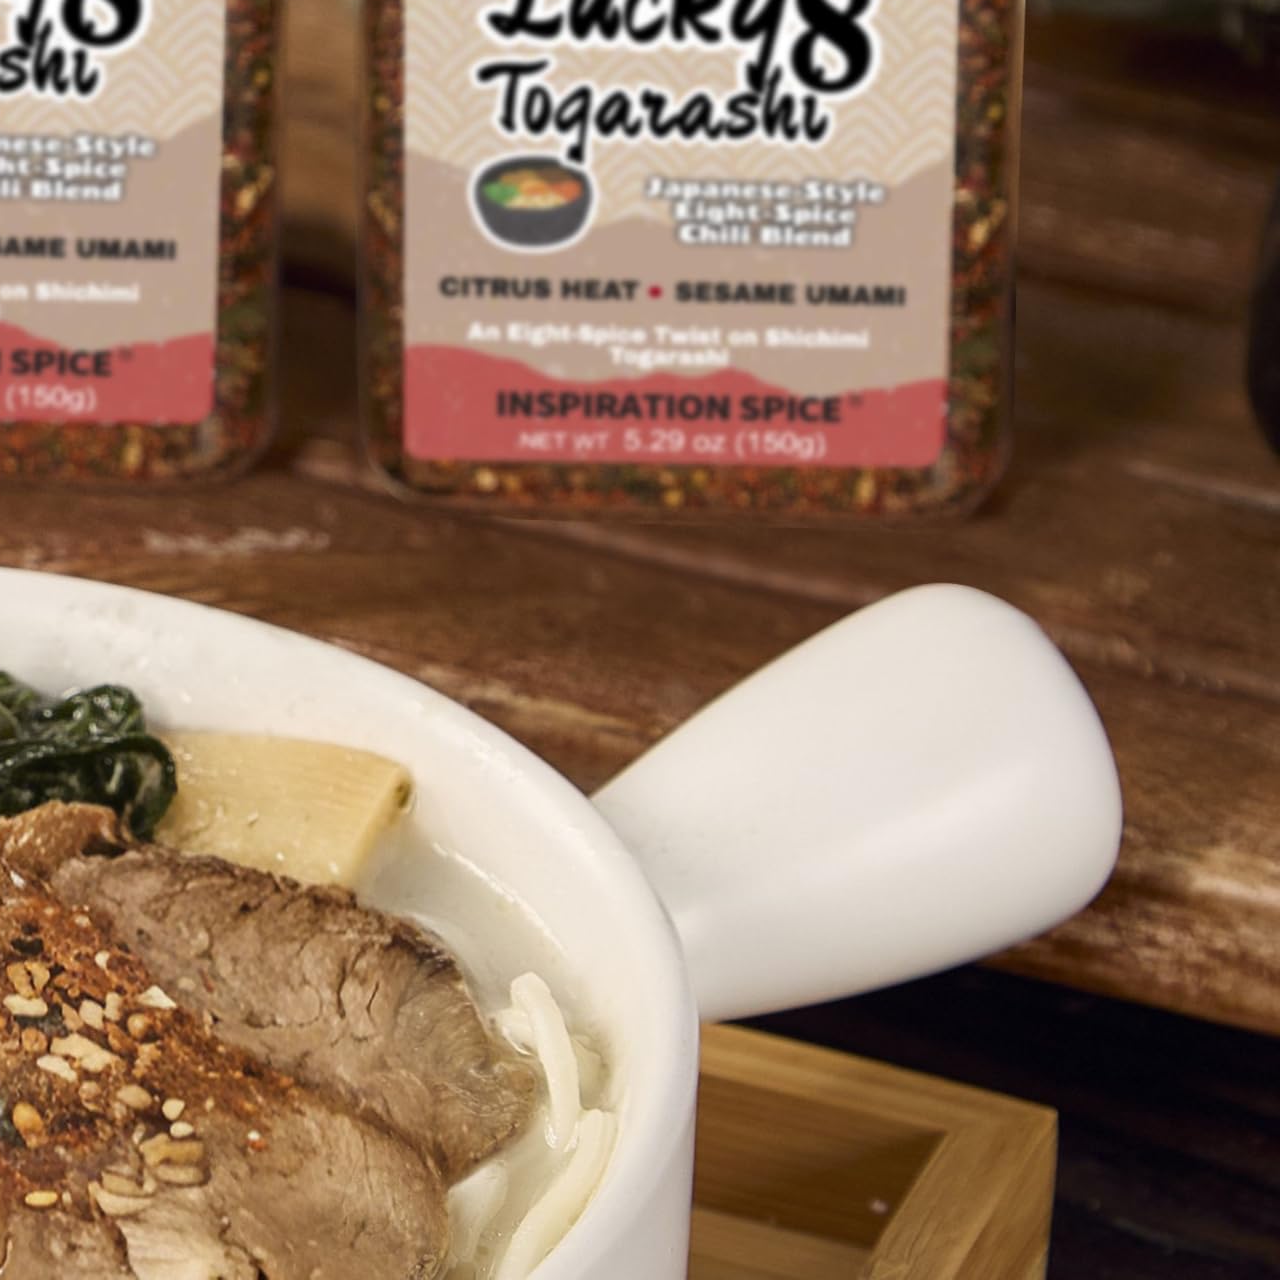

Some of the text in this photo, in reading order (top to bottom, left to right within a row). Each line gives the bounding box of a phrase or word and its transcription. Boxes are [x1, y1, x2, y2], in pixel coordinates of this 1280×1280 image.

[477, 58, 832, 164] Togarashi
[30, 180, 122, 201] Blend
[679, 224, 852, 247] Chili Blend
[76, 239, 177, 260] UMAMI
[0, 287, 28, 300] on
[439, 277, 907, 306] CITRUS HEAT SESAME UMAMI
[467, 323, 501, 341] An
[507, 324, 646, 346] Eight-Spice
[654, 328, 720, 345] Twist
[729, 333, 758, 346] on
[610, 346, 730, 369] Togarashi
[4, 386, 98, 412] (150g)
[496, 391, 731, 420] INSPIRATION
[517, 431, 565, 451] NET
[624, 428, 686, 453] 5.29
[693, 435, 726, 454] oz
[734, 432, 828, 458] (150g)
